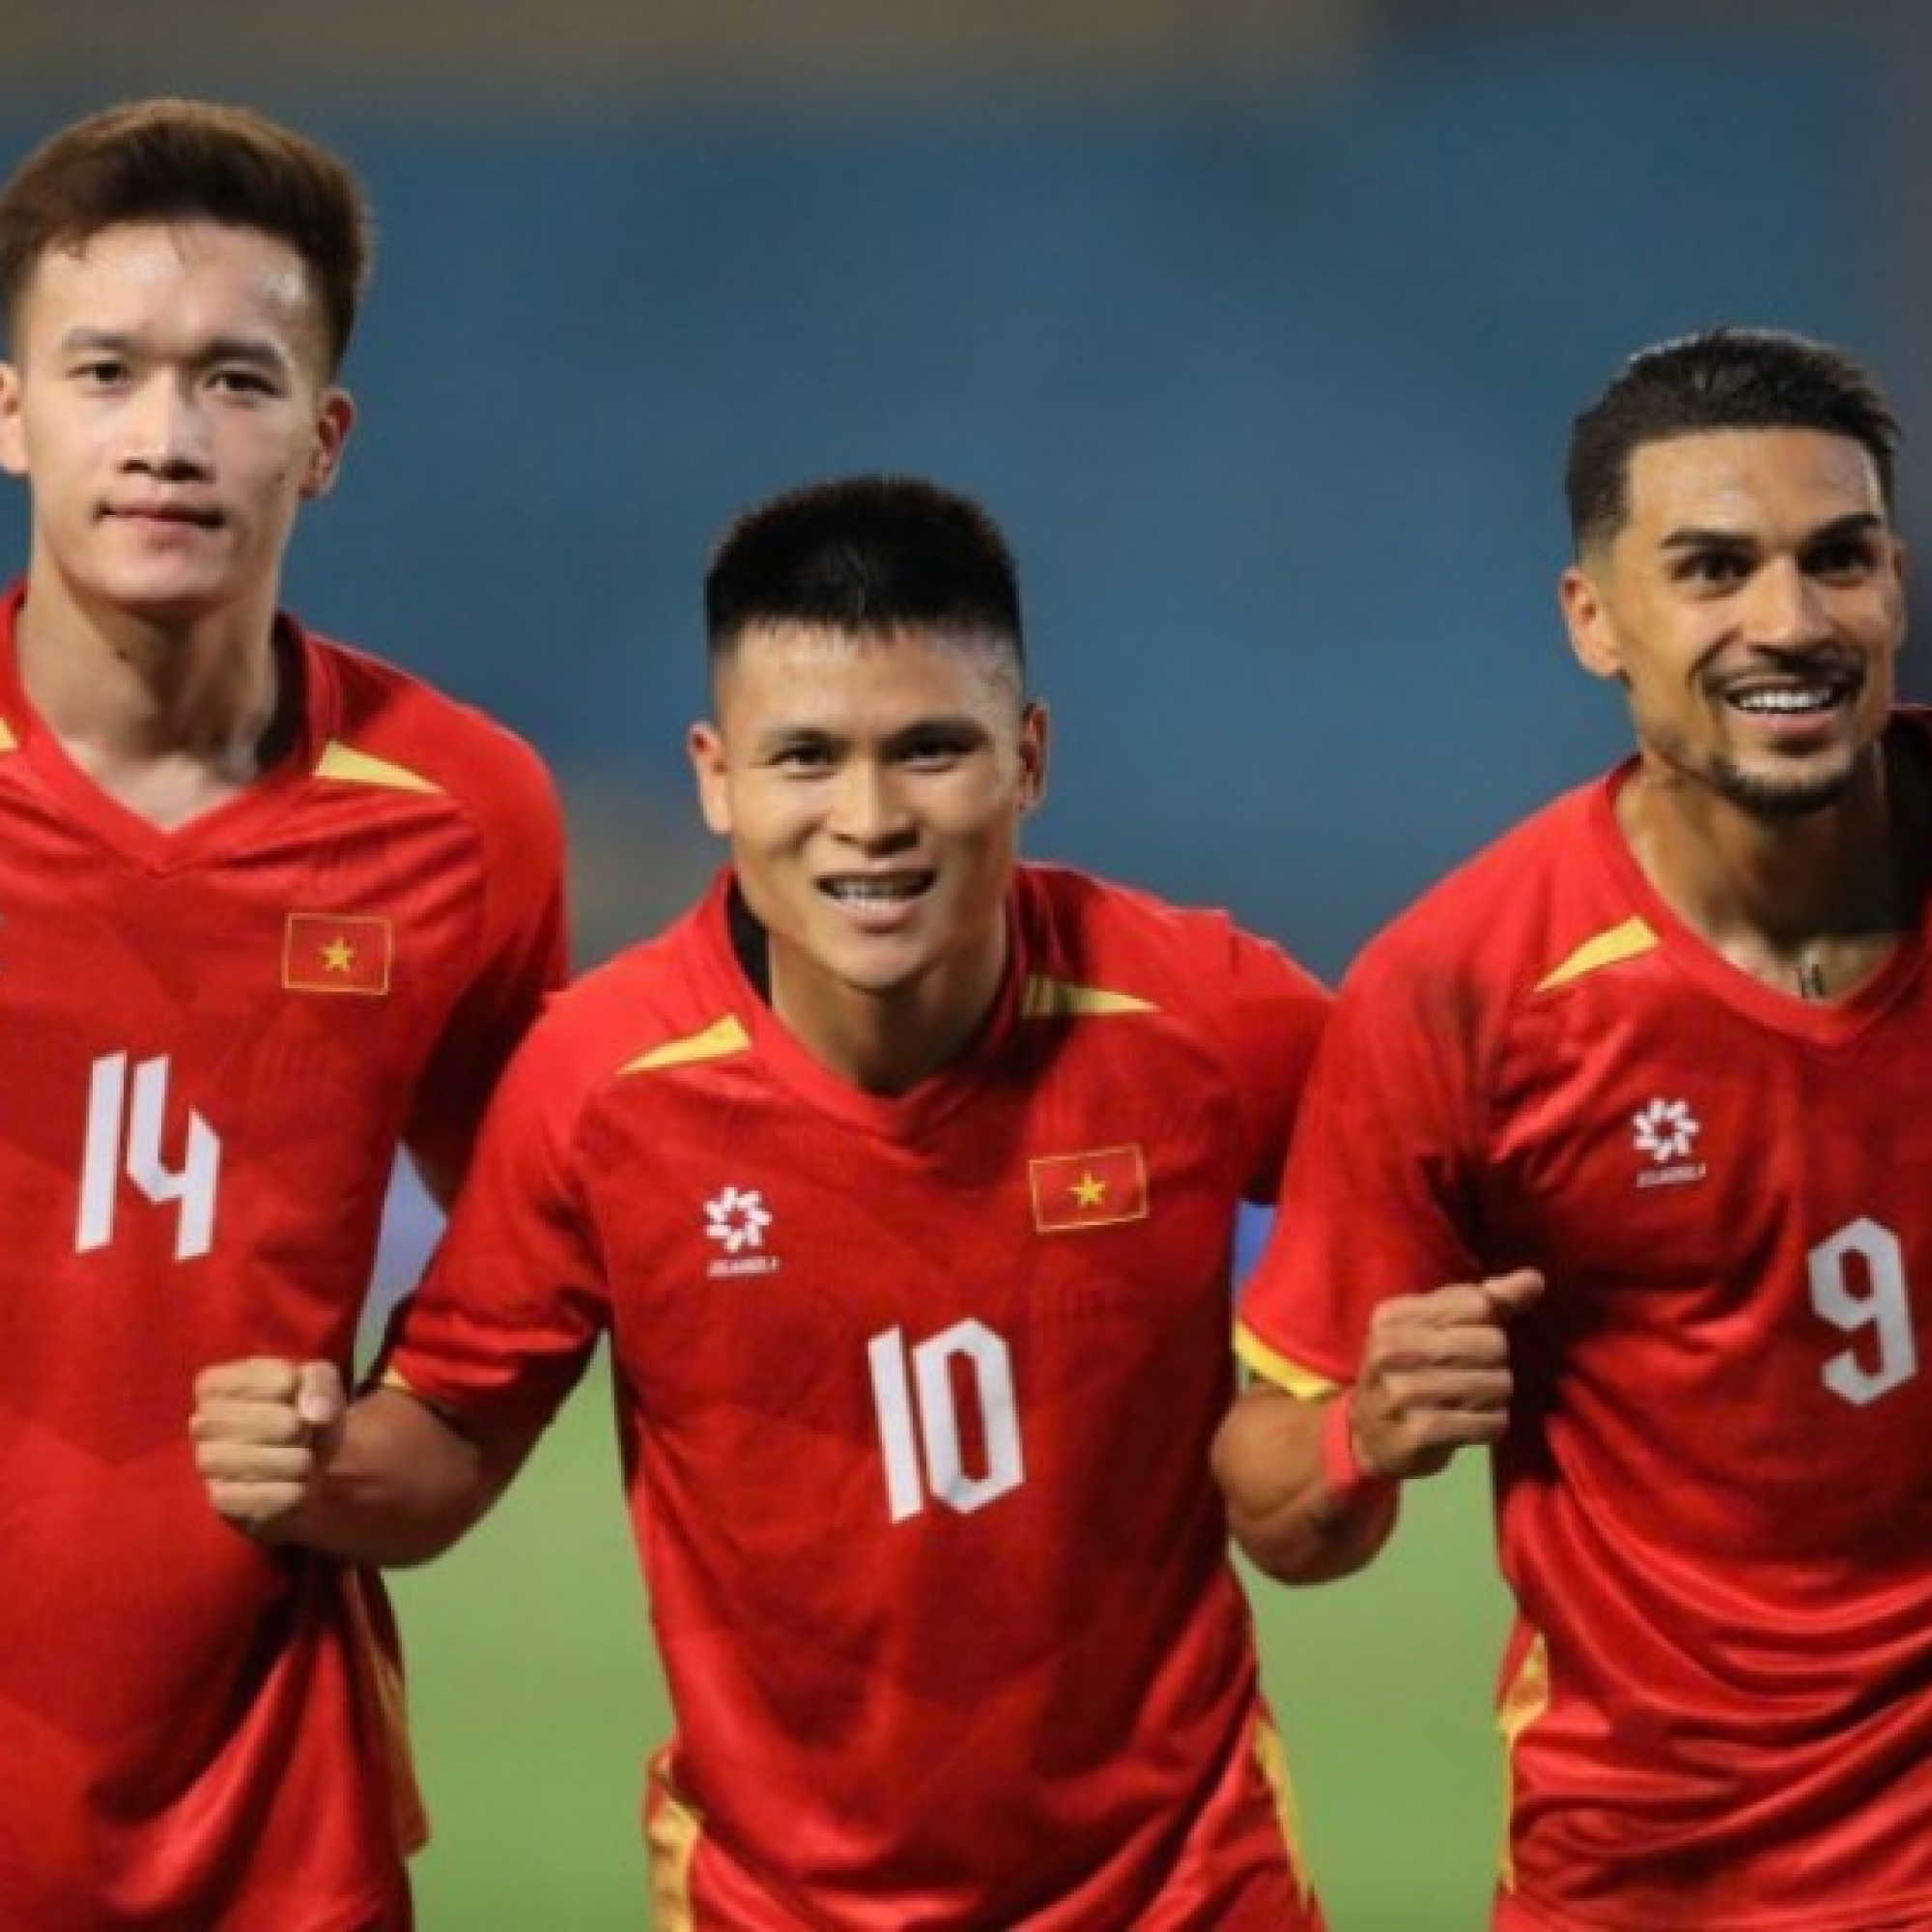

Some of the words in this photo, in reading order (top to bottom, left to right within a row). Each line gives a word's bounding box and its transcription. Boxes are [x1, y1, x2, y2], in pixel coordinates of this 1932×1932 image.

[74, 1050, 221, 1263] 14
[1807, 1216, 1918, 1406] 9
[867, 1317, 1024, 1524] 10
